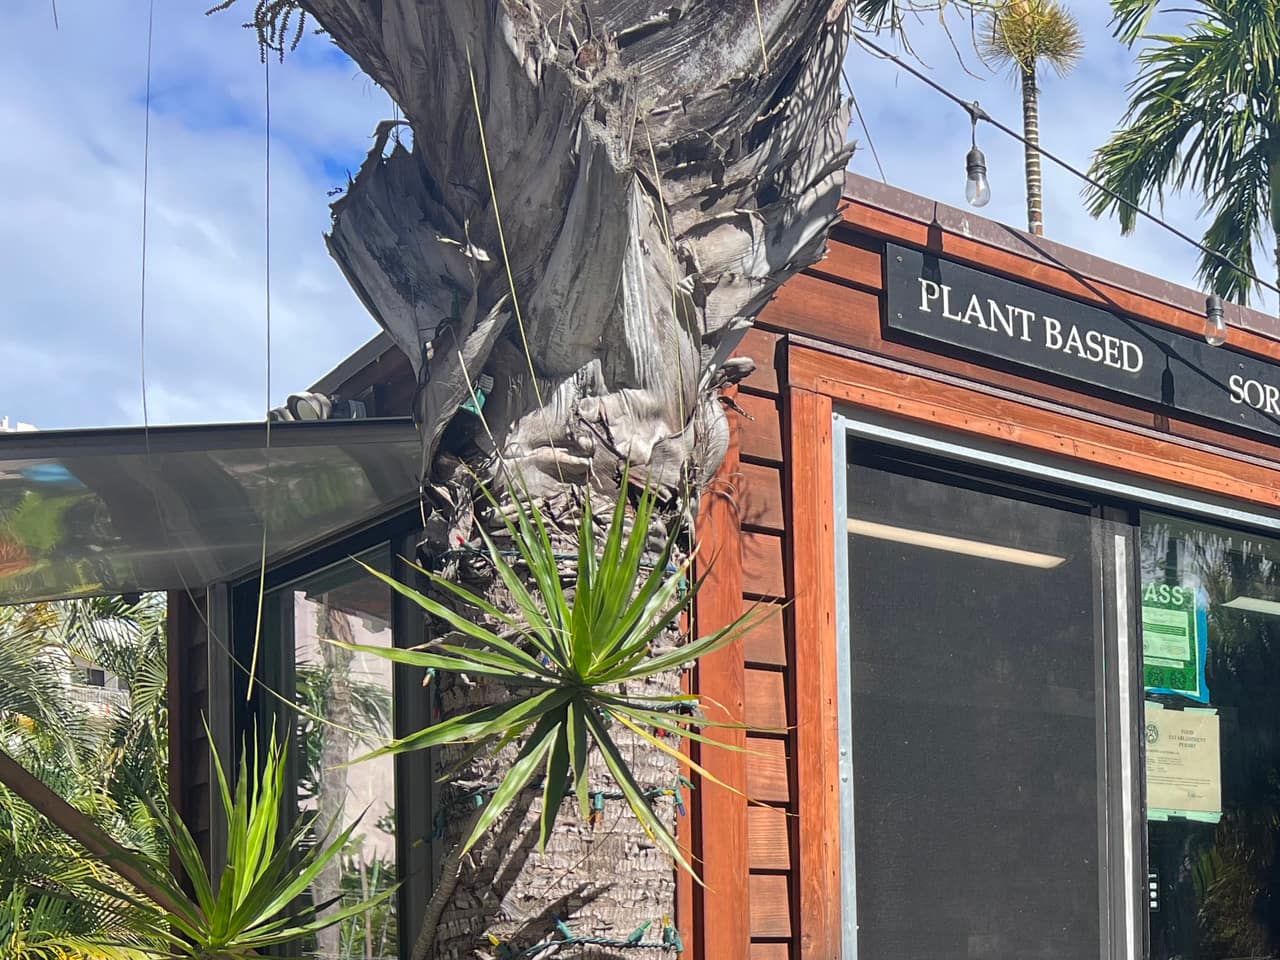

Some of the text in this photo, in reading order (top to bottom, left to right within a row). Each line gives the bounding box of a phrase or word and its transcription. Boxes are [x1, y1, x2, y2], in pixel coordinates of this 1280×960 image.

[918, 278, 1143, 373] PLANT BASED
[1144, 582, 1184, 605] ASS
